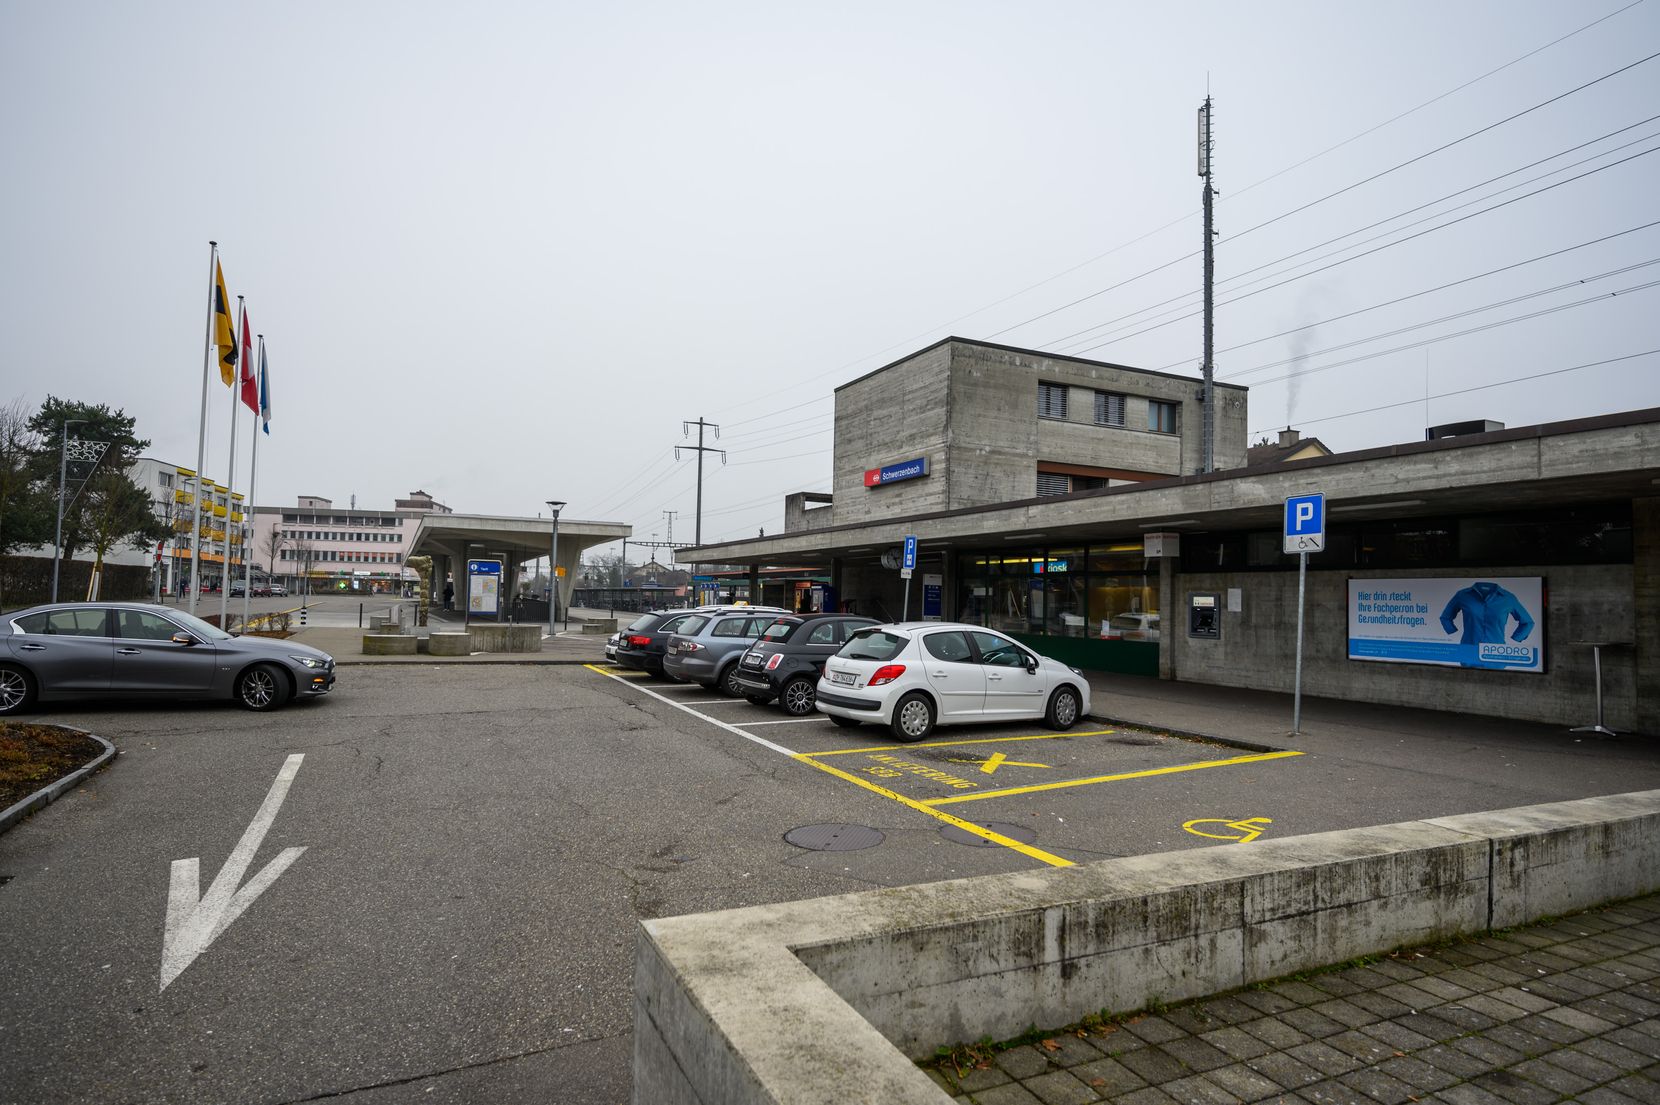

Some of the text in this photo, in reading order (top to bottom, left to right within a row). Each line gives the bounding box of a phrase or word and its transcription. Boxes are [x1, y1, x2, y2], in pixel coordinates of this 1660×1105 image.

[882, 465, 920, 480] Schwerzenbach
[1296, 502, 1314, 531] P
[907, 539, 914, 554] P
[1358, 592, 1412, 601] Hier drin steckt
[1358, 603, 1428, 615] Ihre Fachperson bei
[1358, 615, 1427, 627] Gesundheitsfragen.
[1483, 645, 1529, 656] APODRO
